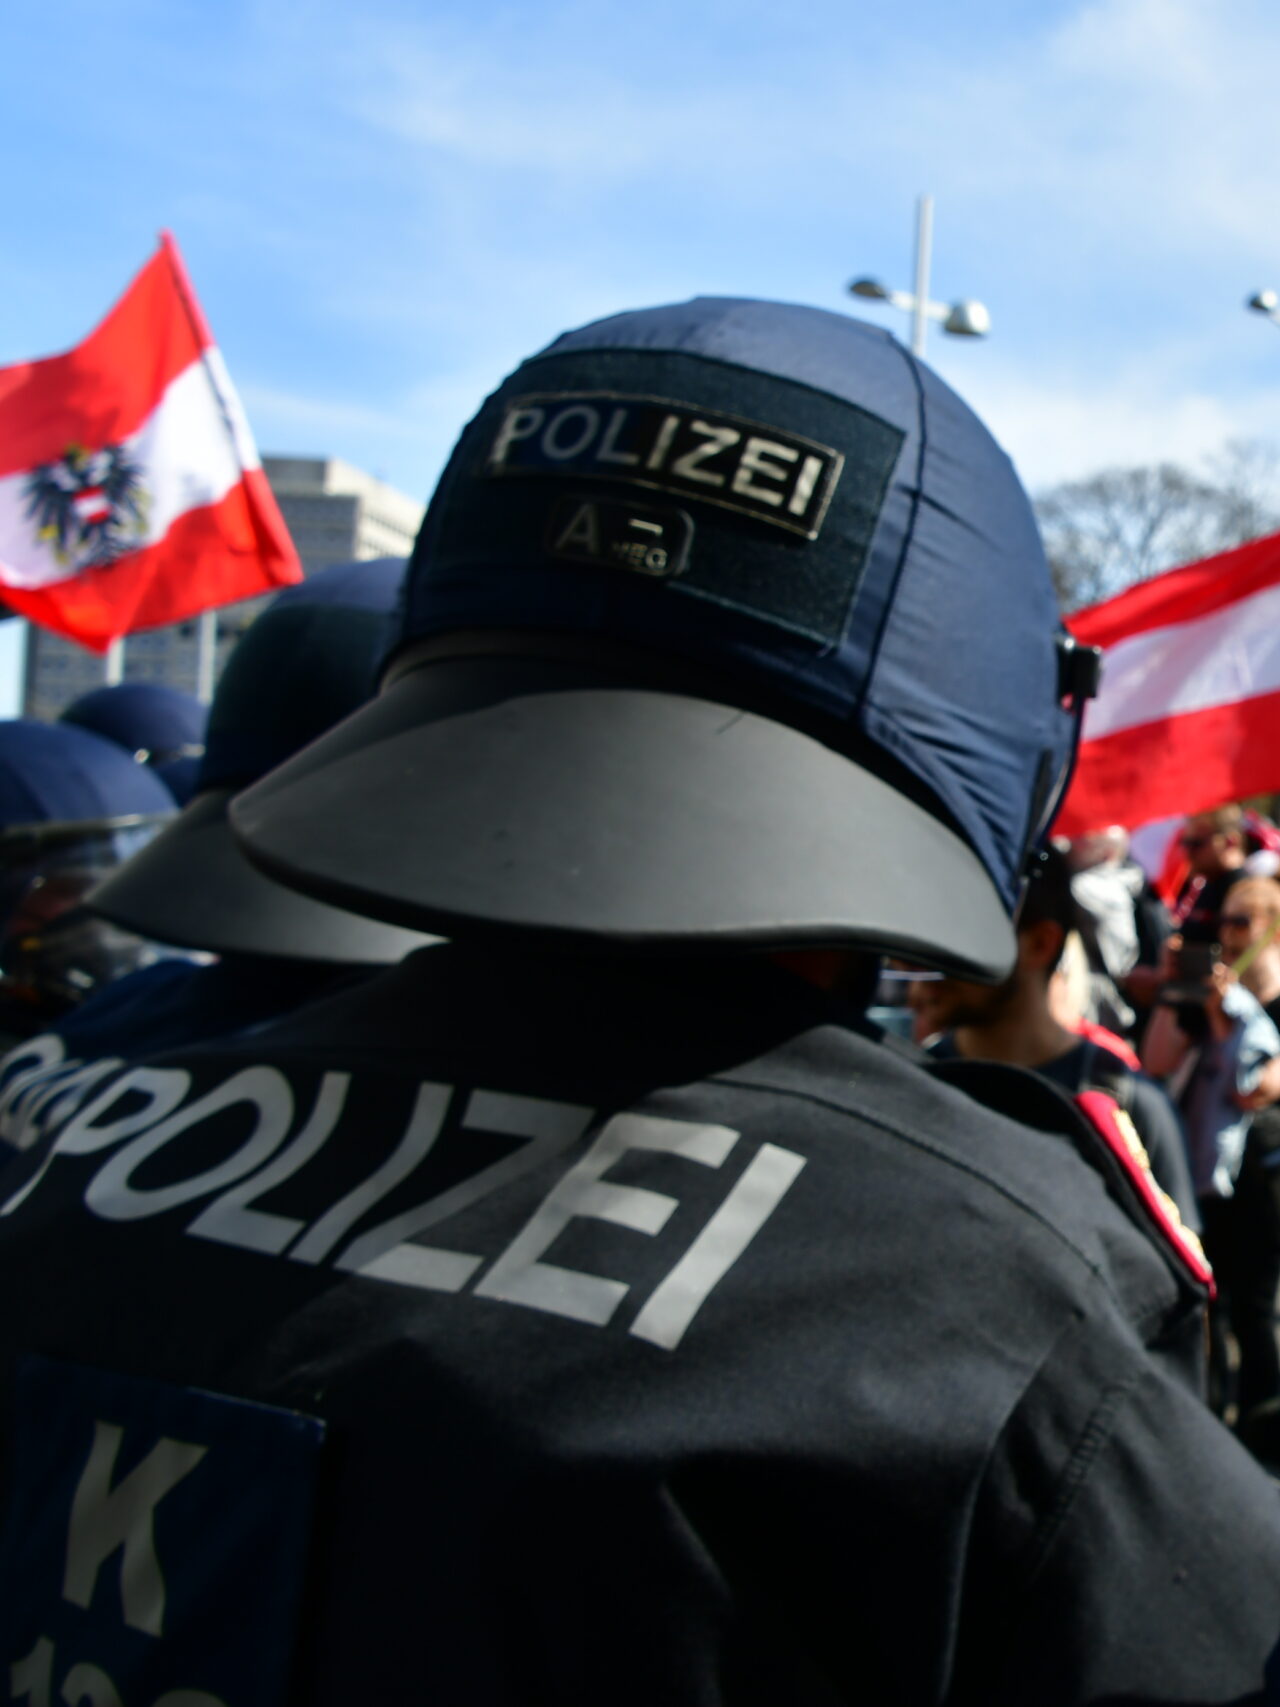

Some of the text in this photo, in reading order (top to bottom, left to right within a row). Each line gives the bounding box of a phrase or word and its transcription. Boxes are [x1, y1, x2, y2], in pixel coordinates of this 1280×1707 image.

[490, 403, 824, 517] POLIZEI
[0, 1066, 807, 1350] POLIZEI
[62, 1419, 209, 1638] K
